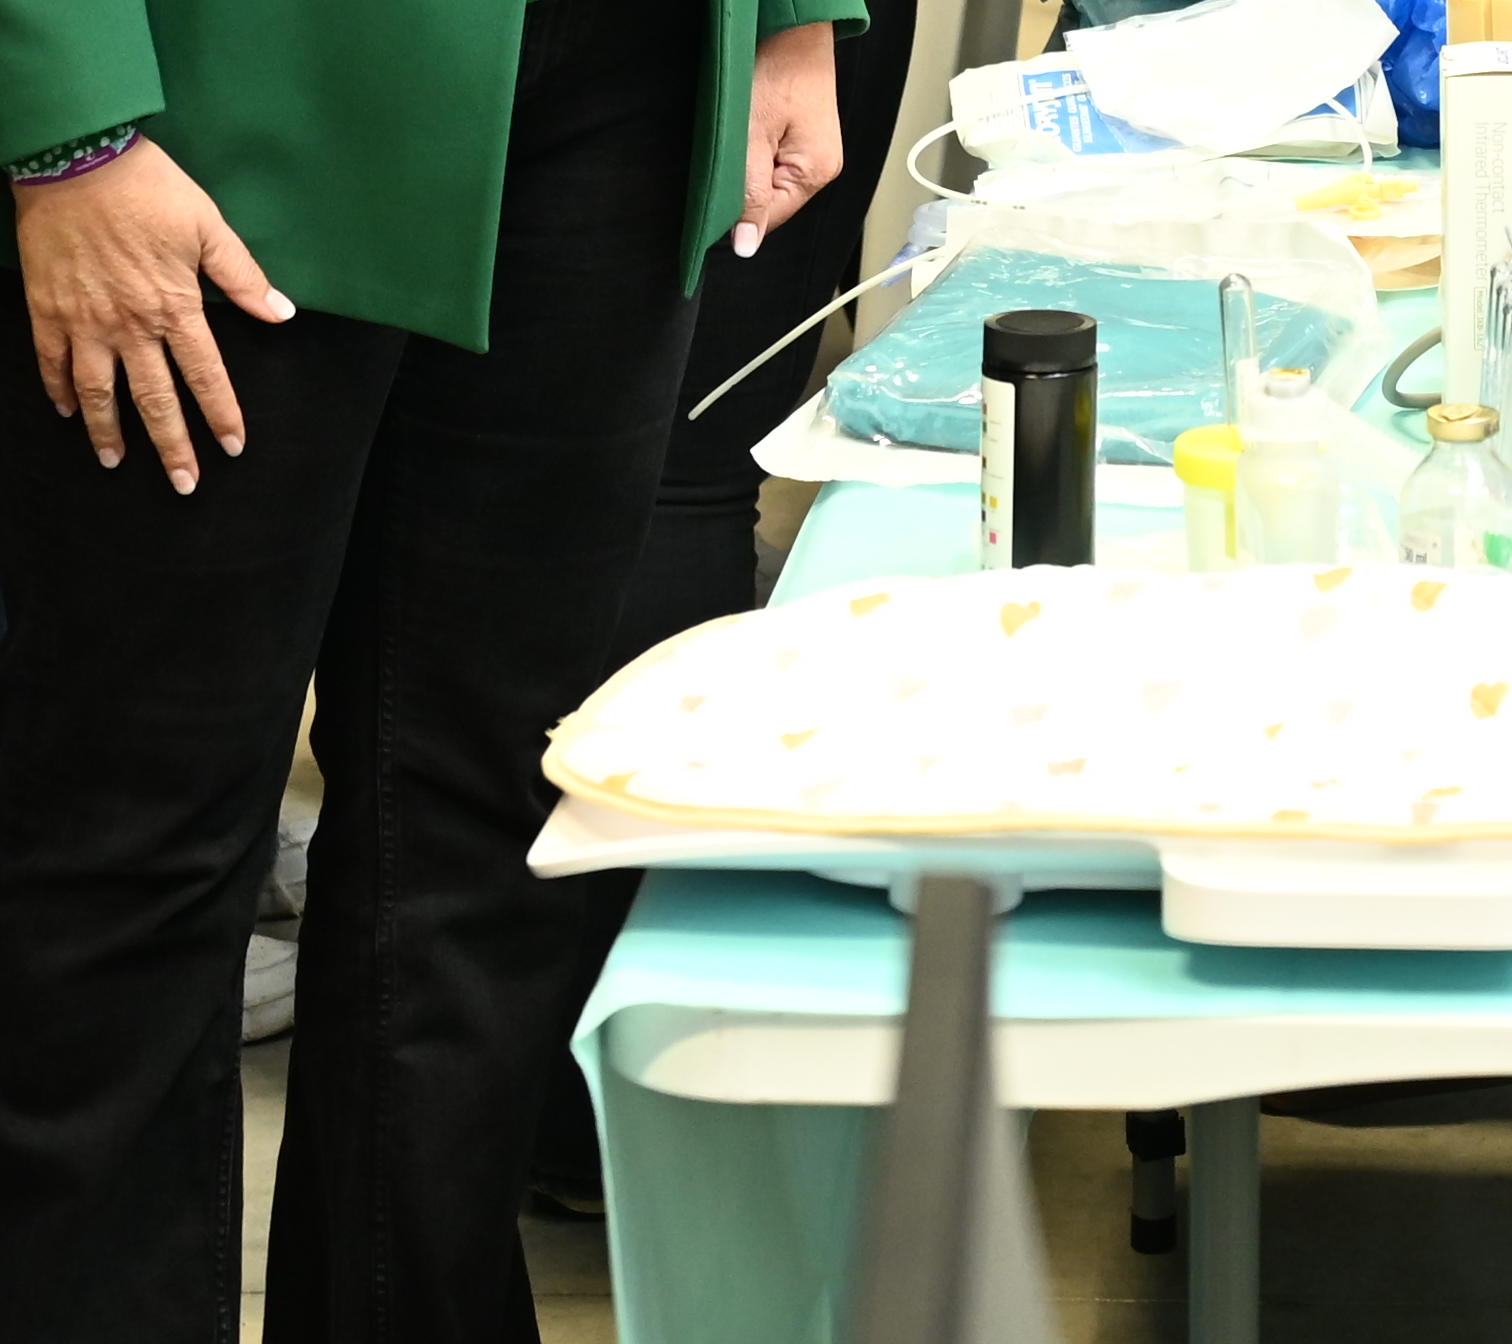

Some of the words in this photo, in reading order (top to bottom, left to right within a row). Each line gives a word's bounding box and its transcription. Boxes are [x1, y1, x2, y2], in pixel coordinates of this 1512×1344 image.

[1475, 121, 1490, 179] Infrared
[1491, 121, 1507, 214] Non-contact
[1475, 183, 1491, 282] Thermometer
